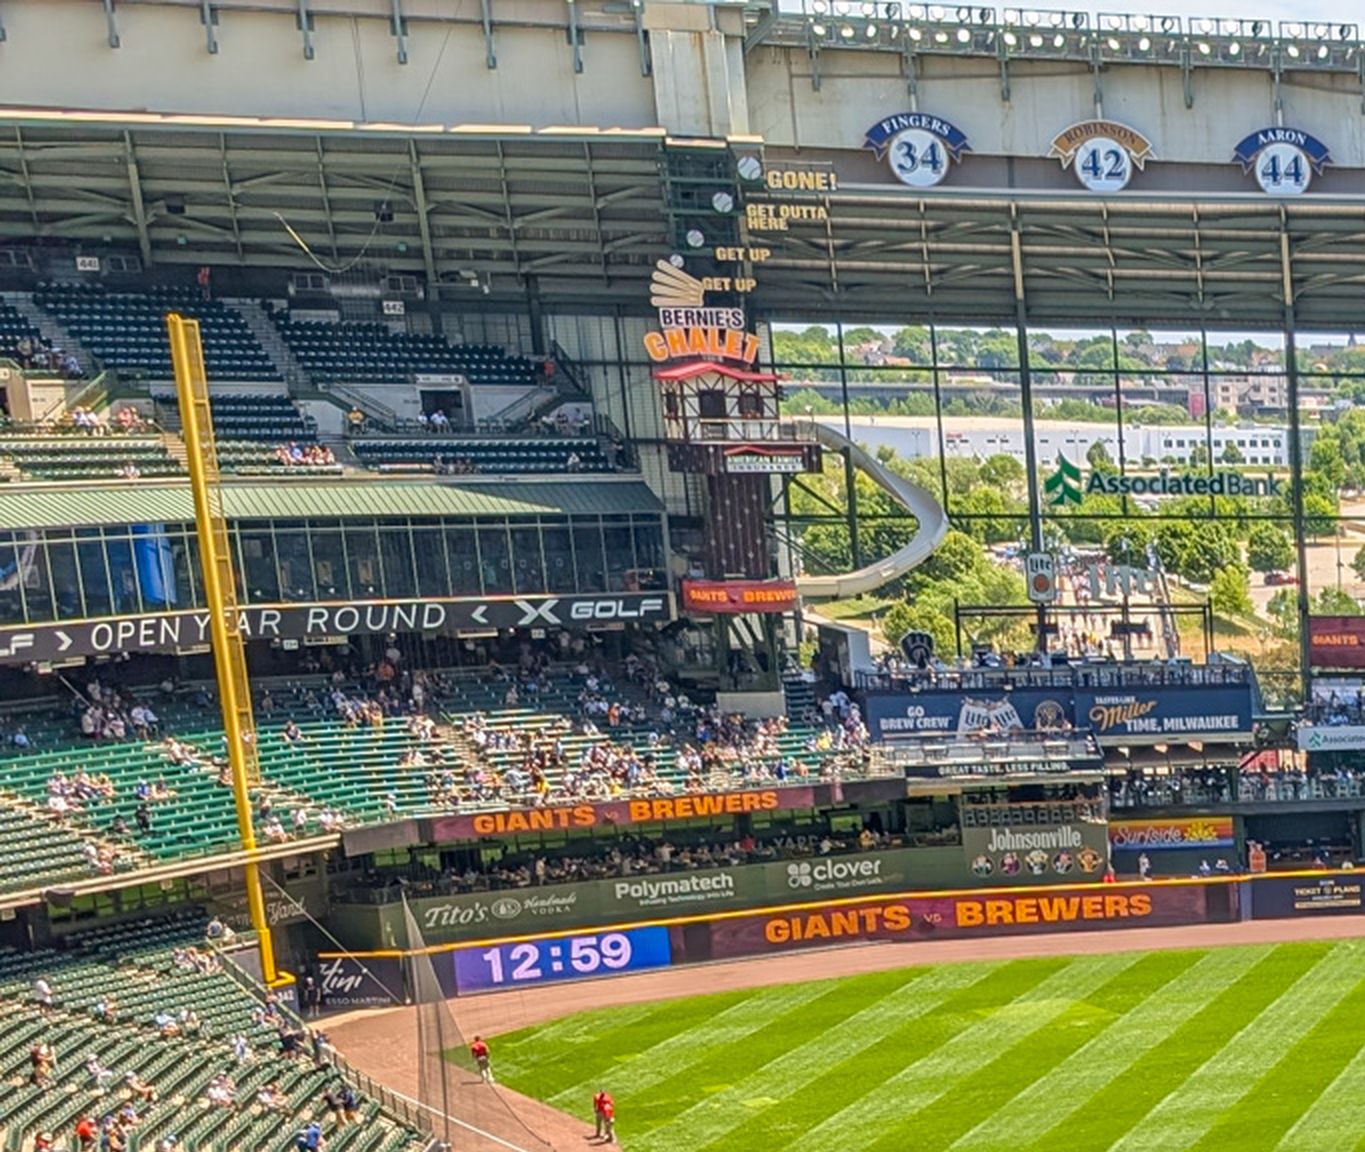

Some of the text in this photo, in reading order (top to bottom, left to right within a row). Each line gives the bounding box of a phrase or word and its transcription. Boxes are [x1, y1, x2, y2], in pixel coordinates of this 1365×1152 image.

[881, 114, 951, 136] FINGERS
[1065, 122, 1140, 145] ROBINSON
[1257, 129, 1308, 146] AARON
[896, 141, 942, 175] 34
[1081, 148, 1126, 181] 42
[767, 170, 838, 191] GONE!
[1261, 154, 1304, 187] 44
[746, 204, 828, 219] GET OUTTA
[747, 217, 789, 231] HERE
[715, 247, 771, 262] GET UP
[702, 277, 757, 292] GET UP
[661, 309, 744, 327] BERNIE'S
[643, 327, 761, 363] CHALET
[90, 616, 181, 651] OPEN
[194, 608, 282, 641] YAR
[306, 603, 446, 633] ROUND
[570, 598, 662, 620] GOLF
[906, 705, 925, 718] GO
[1088, 699, 1159, 732] Miller
[879, 717, 914, 731] BREW
[916, 717, 950, 730] CREW
[1126, 715, 1239, 733] TIME, MILWAUKEE
[938, 766, 970, 776] GREAT
[473, 790, 779, 835] GIANTS BREWERS
[987, 826, 1082, 852] Johnsonville
[1112, 826, 1182, 846] Surfside
[813, 856, 881, 882] clover
[615, 873, 734, 899] Polymatech
[423, 901, 490, 929] Tito's
[530, 904, 571, 916] VODKA
[764, 894, 1153, 943] GIANTS BREWERS
[483, 932, 633, 984] 12:59
